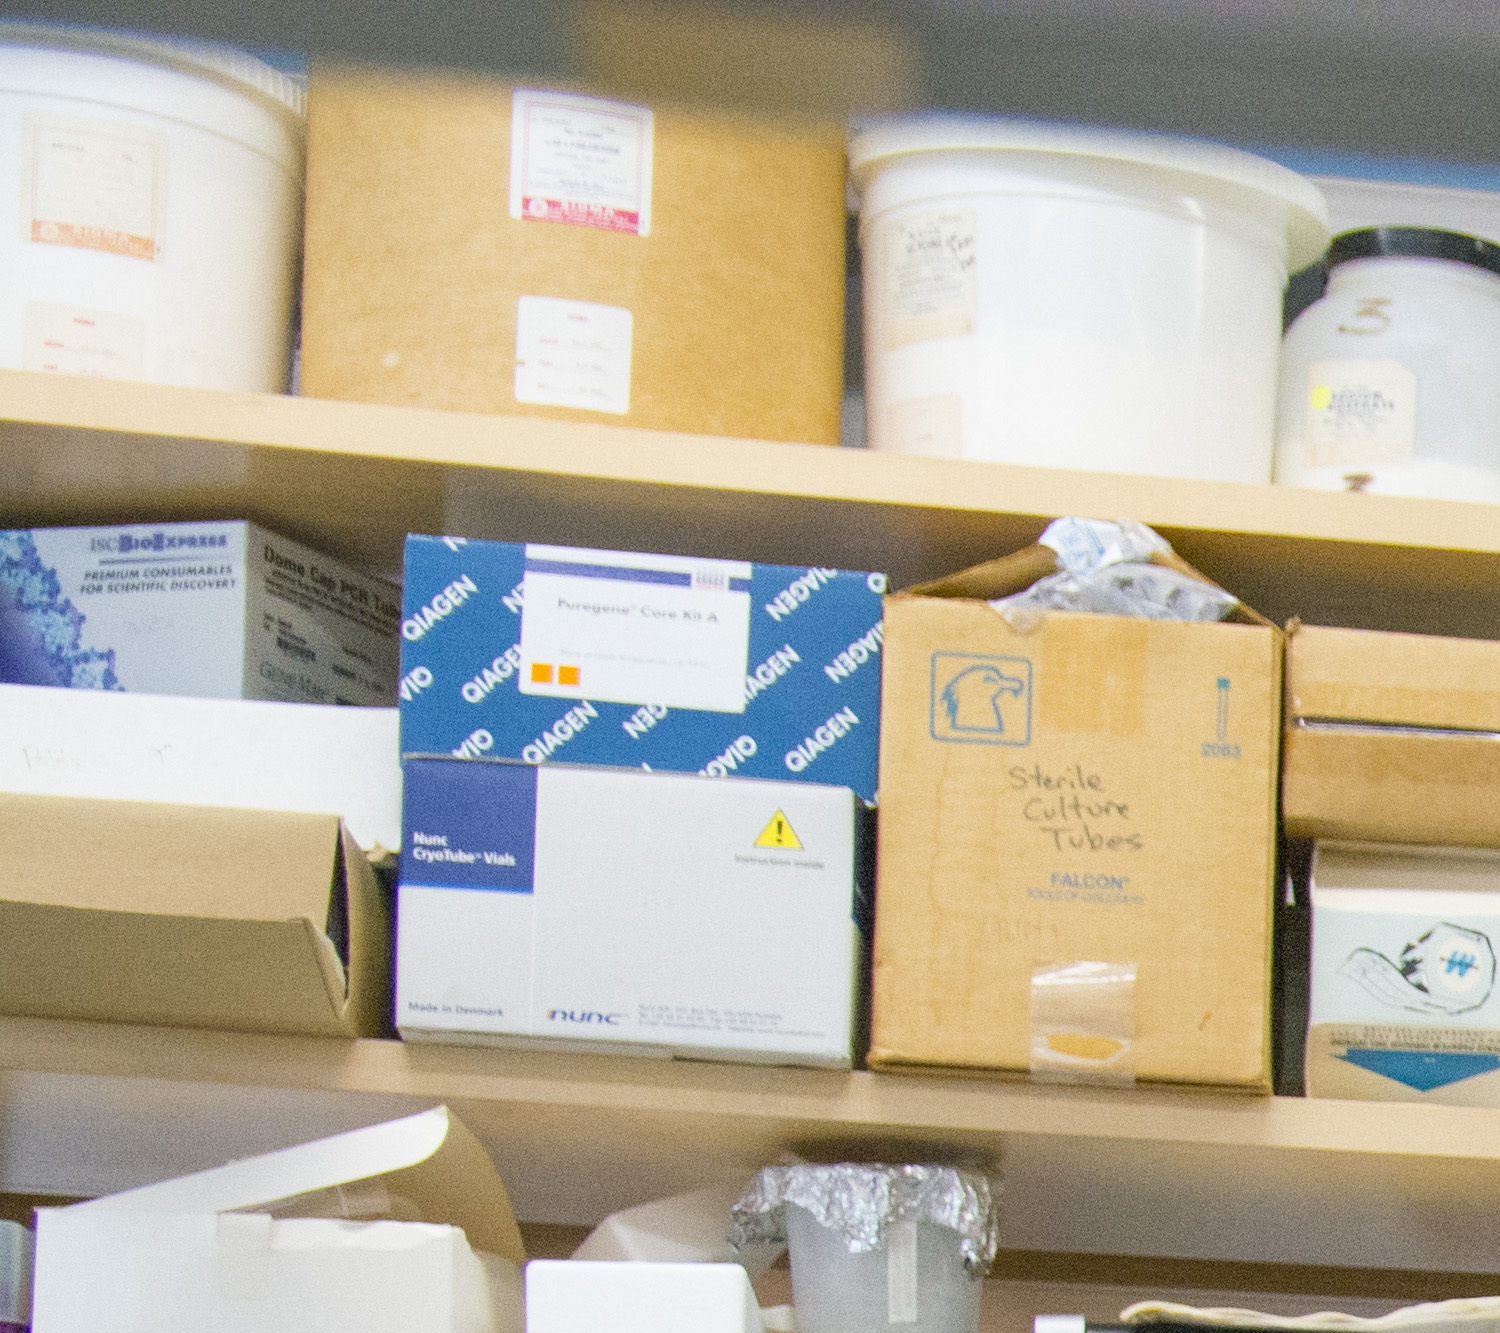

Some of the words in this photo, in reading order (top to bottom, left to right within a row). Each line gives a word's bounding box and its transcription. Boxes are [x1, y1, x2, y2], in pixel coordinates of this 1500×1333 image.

[80, 583, 104, 595] FOR
[106, 581, 167, 594] SCIENTIFIC
[169, 578, 237, 592] DISCOVERY
[84, 569, 140, 582] PREMIUM
[142, 565, 233, 579] CONSUMABLES
[402, 575, 478, 642] QIAGEN
[521, 700, 599, 766] QIAGEN
[783, 706, 861, 774] QIAGEN
[1008, 764, 1107, 793] Sterile
[1022, 796, 1132, 823] Culture
[412, 830, 448, 847] Nunc
[1039, 823, 1144, 852] Tubes
[483, 851, 516, 867] Vials
[408, 1001, 440, 1015] Made
[442, 1003, 453, 1016] in
[454, 1003, 504, 1019] Denmark
